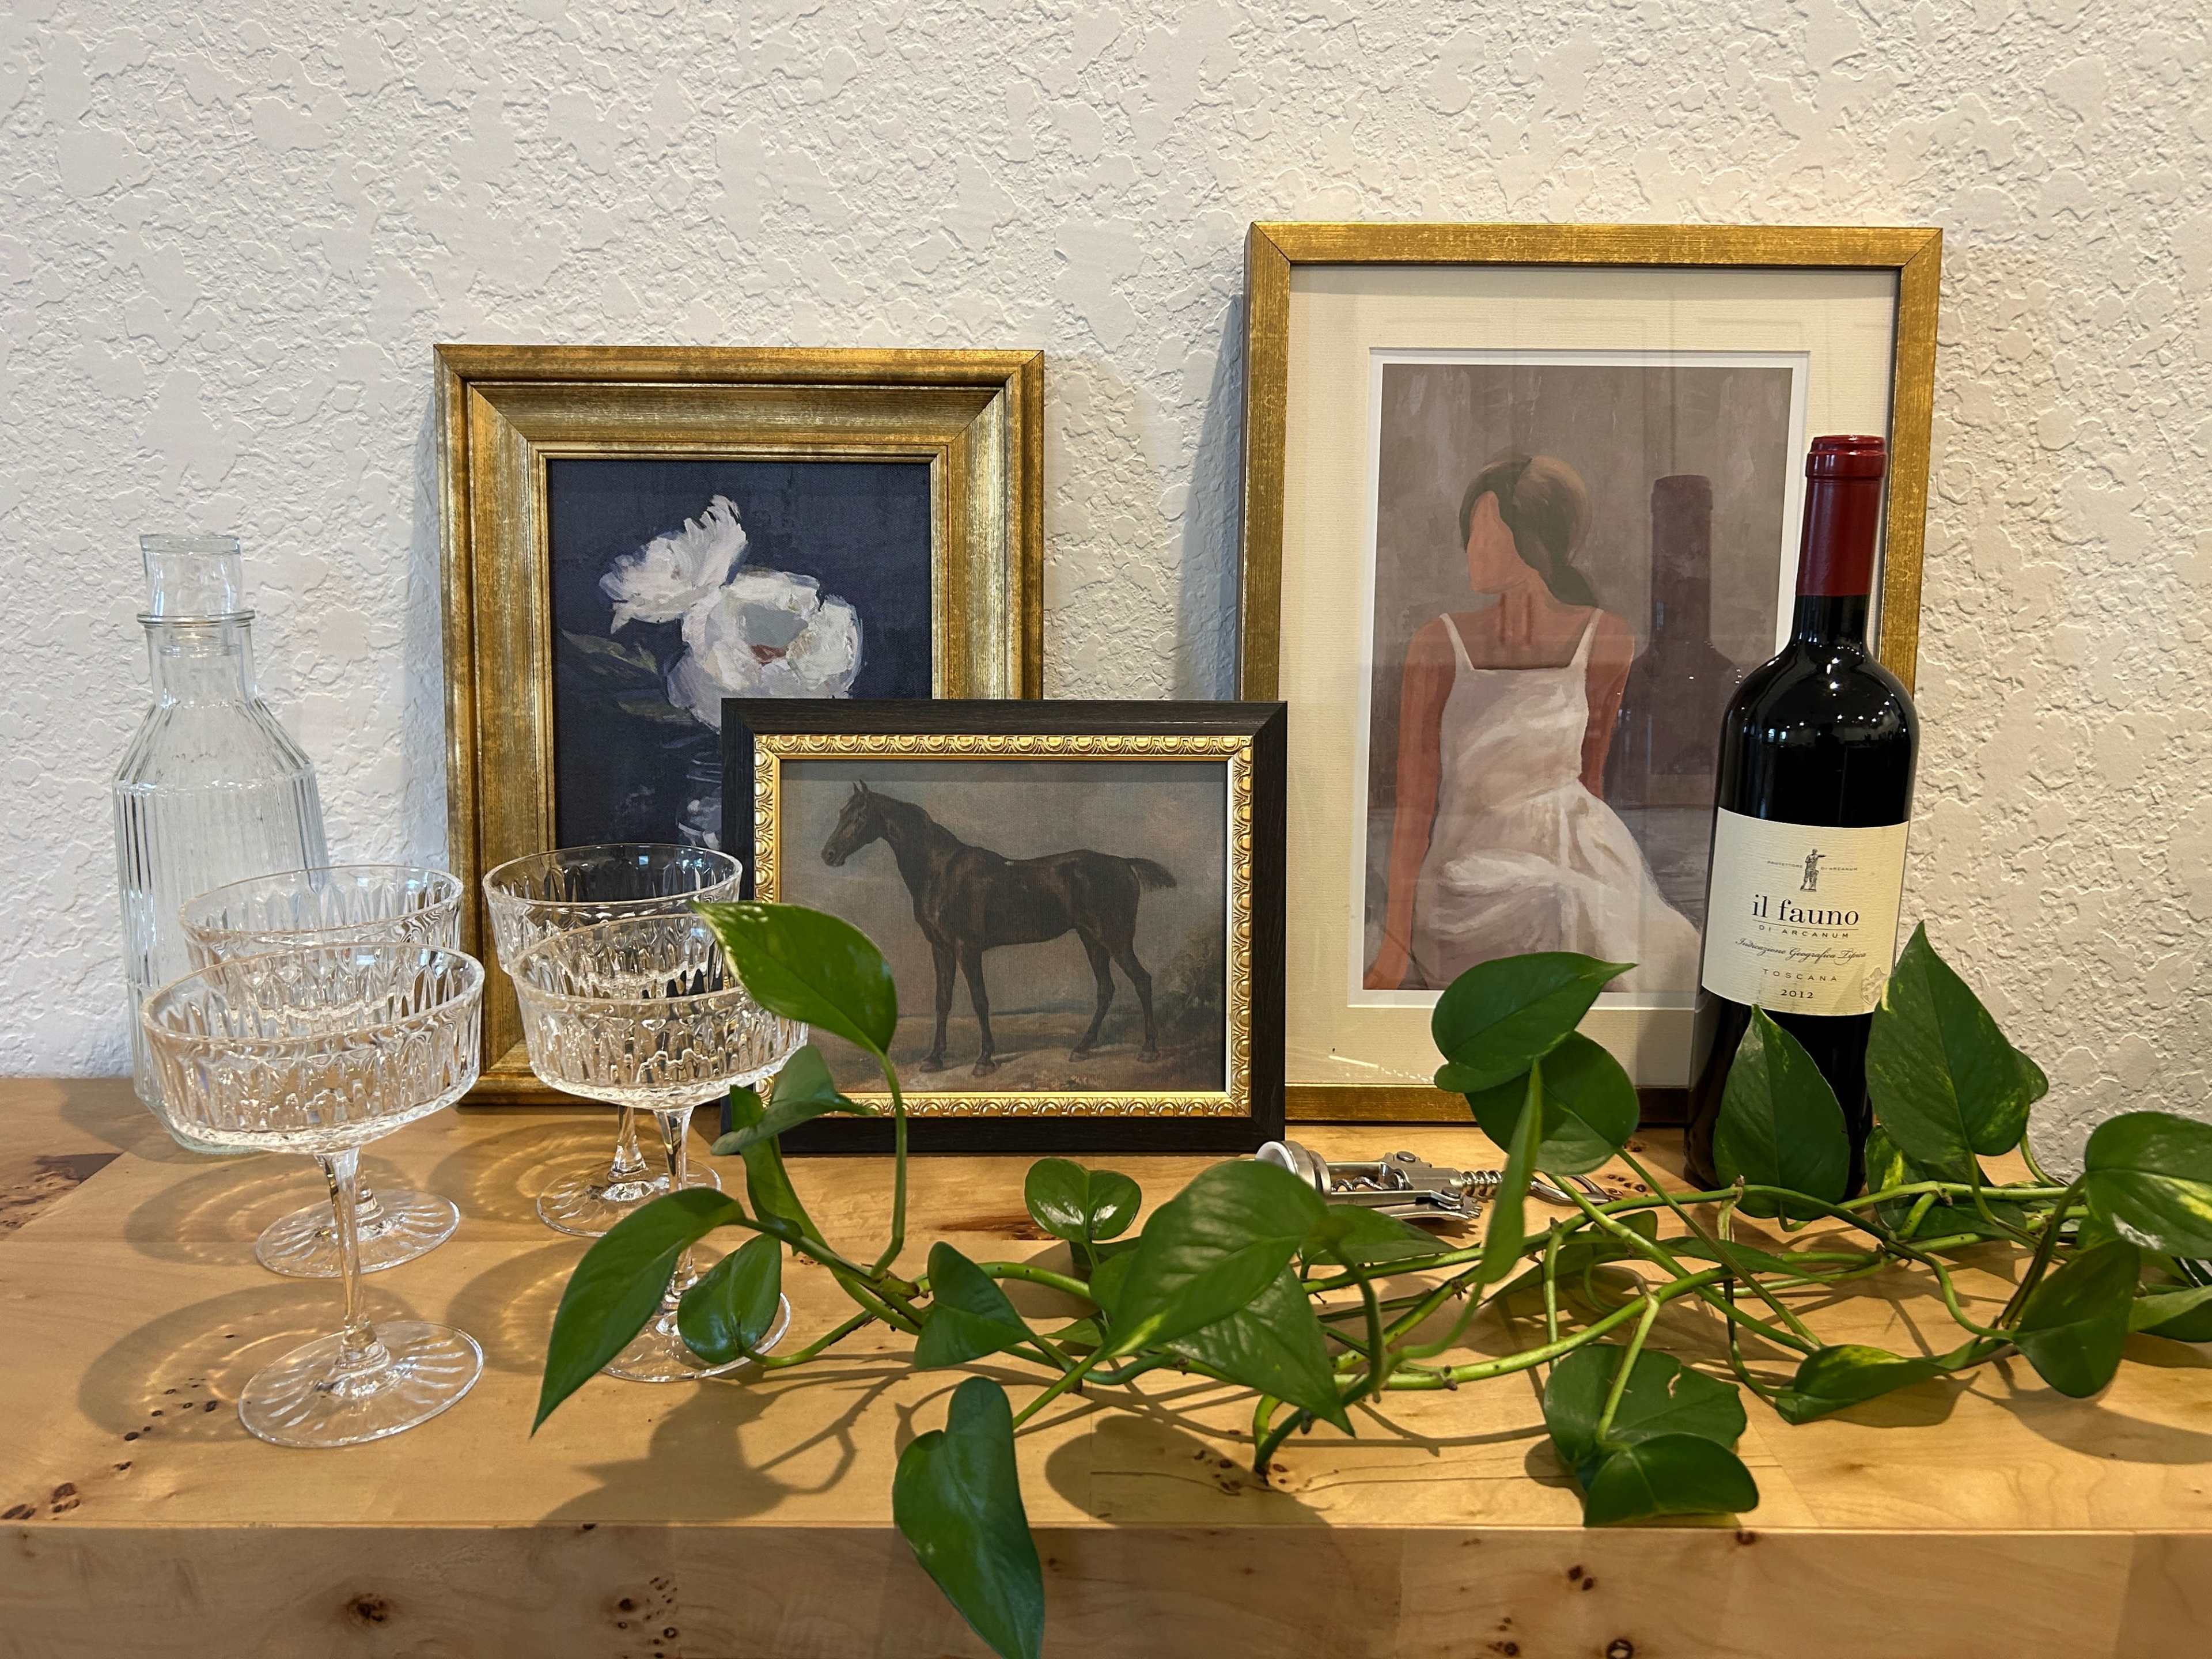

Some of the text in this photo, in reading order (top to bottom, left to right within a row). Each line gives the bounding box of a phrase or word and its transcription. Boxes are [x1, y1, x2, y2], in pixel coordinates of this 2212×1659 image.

[1752, 894, 1859, 926] il fauno
[1782, 929, 1849, 938] ARCANUM
[1735, 938, 1786, 956] Indicazione
[1785, 946, 1835, 964] Geografica
[1762, 968, 1838, 982] TOSCANA
[1780, 988, 1815, 999] 2012
